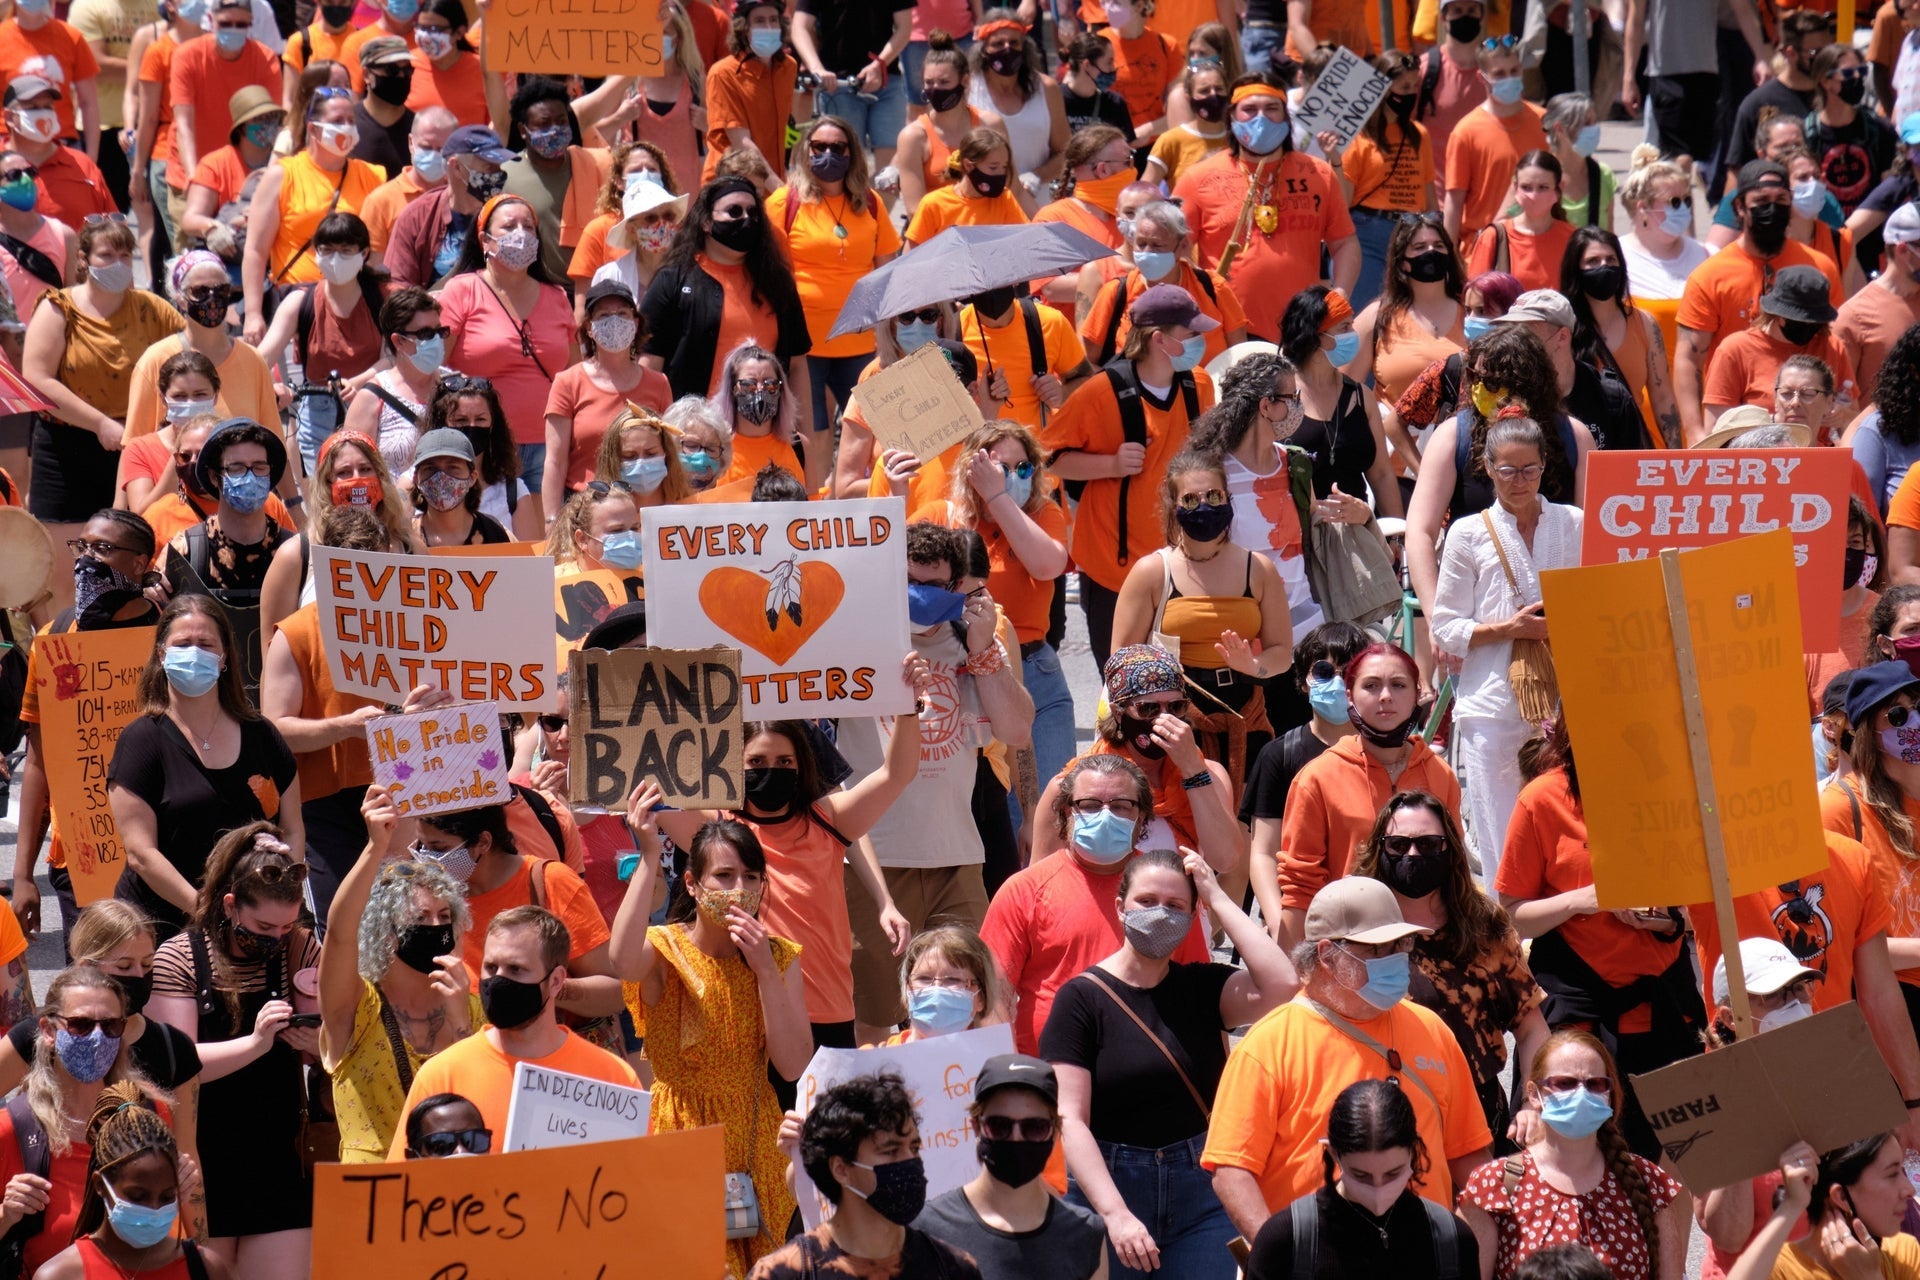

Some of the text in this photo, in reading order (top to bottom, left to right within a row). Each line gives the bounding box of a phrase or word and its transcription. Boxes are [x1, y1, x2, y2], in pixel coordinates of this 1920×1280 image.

[505, 26, 662, 65] MATTERS
[1295, 96, 1325, 127] NO
[1317, 52, 1358, 97] PRIDE
[1324, 93, 1348, 121] IN
[1285, 178, 1309, 194] IS
[864, 386, 906, 412] EVERY
[899, 395, 941, 422] CHILD
[1636, 458, 1801, 486] EVERY
[1599, 494, 1832, 537] CHILD
[658, 516, 891, 560] EVERY CHILD
[329, 558, 498, 612] EVERY
[335, 606, 448, 653] CHILD
[340, 650, 544, 701] MATTERS
[587, 661, 739, 729] LAND
[742, 667, 875, 704] TTERS
[373, 713, 488, 763] No Pride
[423, 755, 444, 773] in
[584, 728, 737, 806] BACK
[523, 1069, 639, 1121] INDIGENOUS
[343, 1173, 526, 1244] There's
